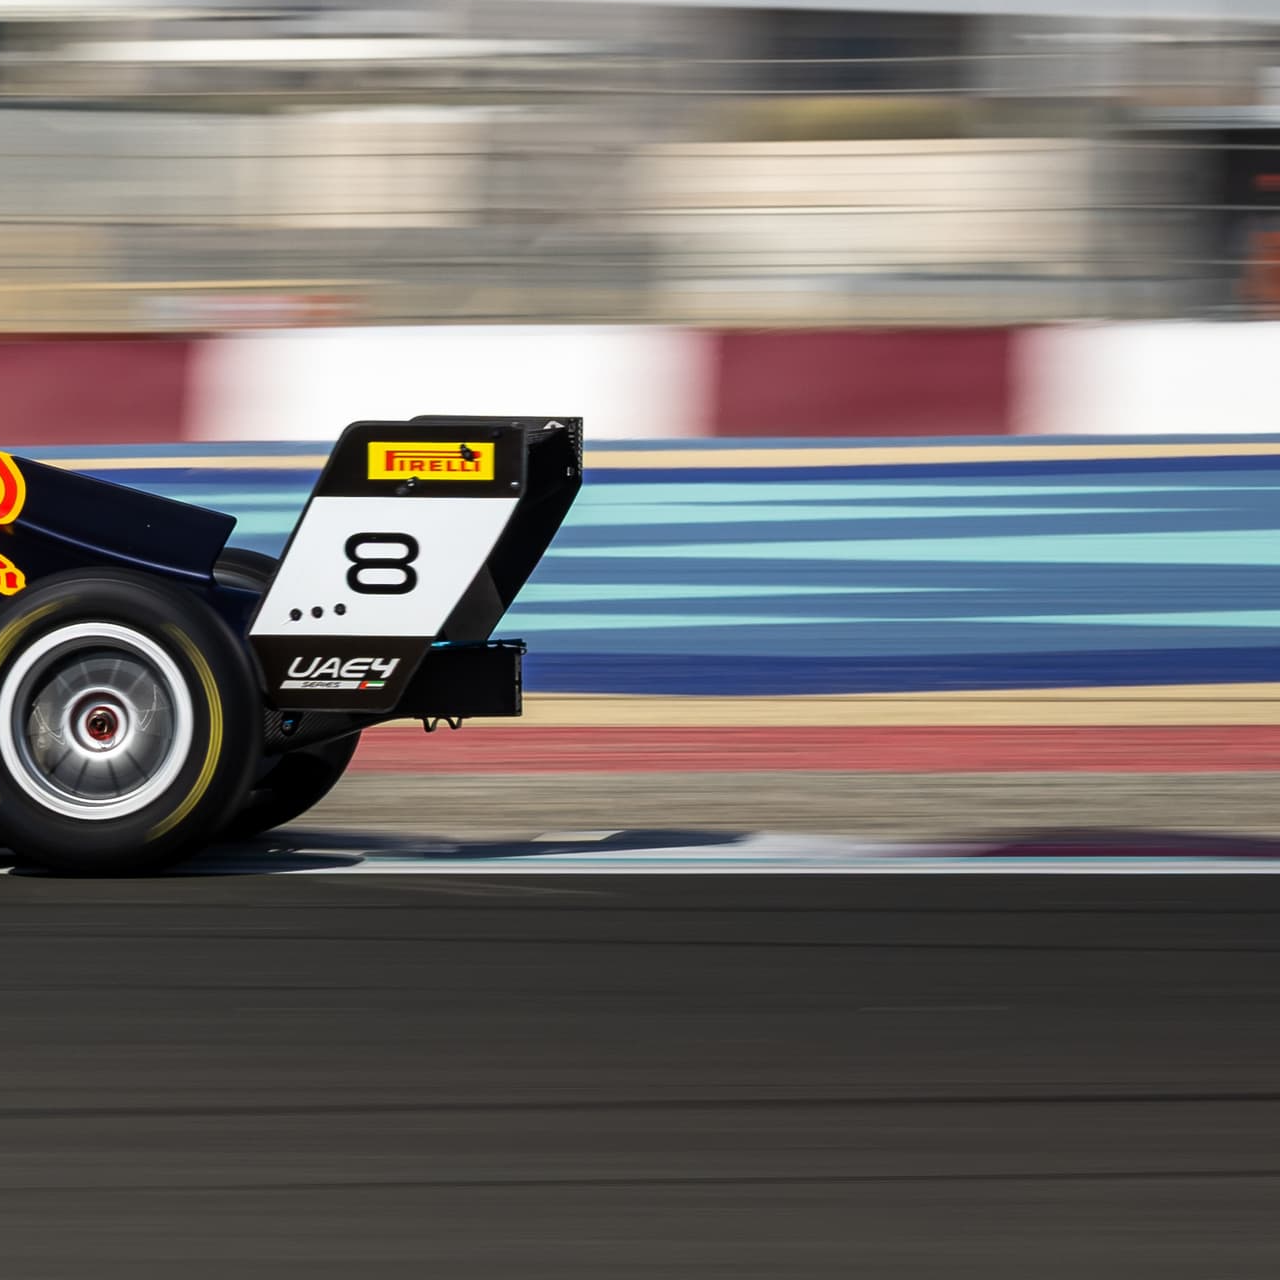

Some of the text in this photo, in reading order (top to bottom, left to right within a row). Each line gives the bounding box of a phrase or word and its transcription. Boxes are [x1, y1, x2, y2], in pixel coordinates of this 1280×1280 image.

[385, 450, 481, 472] PIRELLI
[344, 532, 419, 595] 8
[287, 656, 400, 679] UAE4
